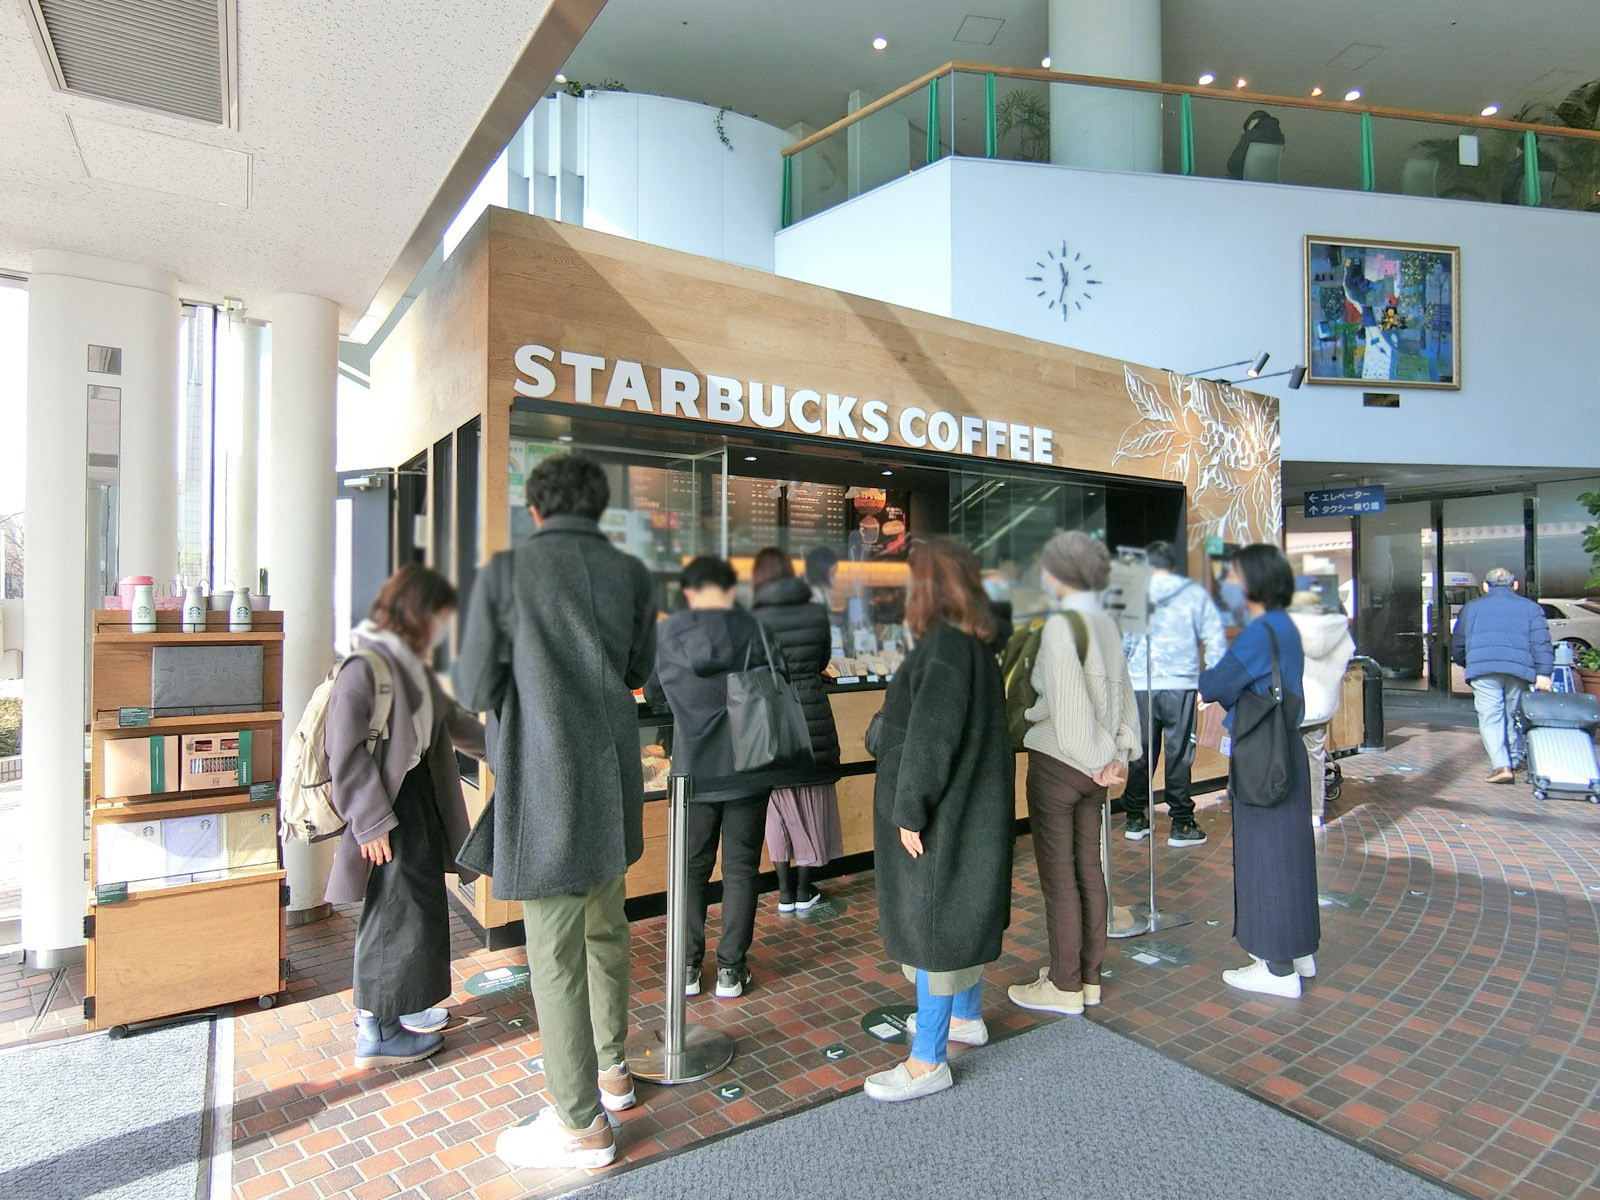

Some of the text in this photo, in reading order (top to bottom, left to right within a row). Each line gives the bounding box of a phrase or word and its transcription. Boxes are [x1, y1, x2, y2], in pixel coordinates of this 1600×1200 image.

[513, 344, 1054, 465] STARBUCKS COFFEE
[1321, 491, 1370, 502] エレベーター
[1321, 501, 1380, 514] タクシー乗り場
